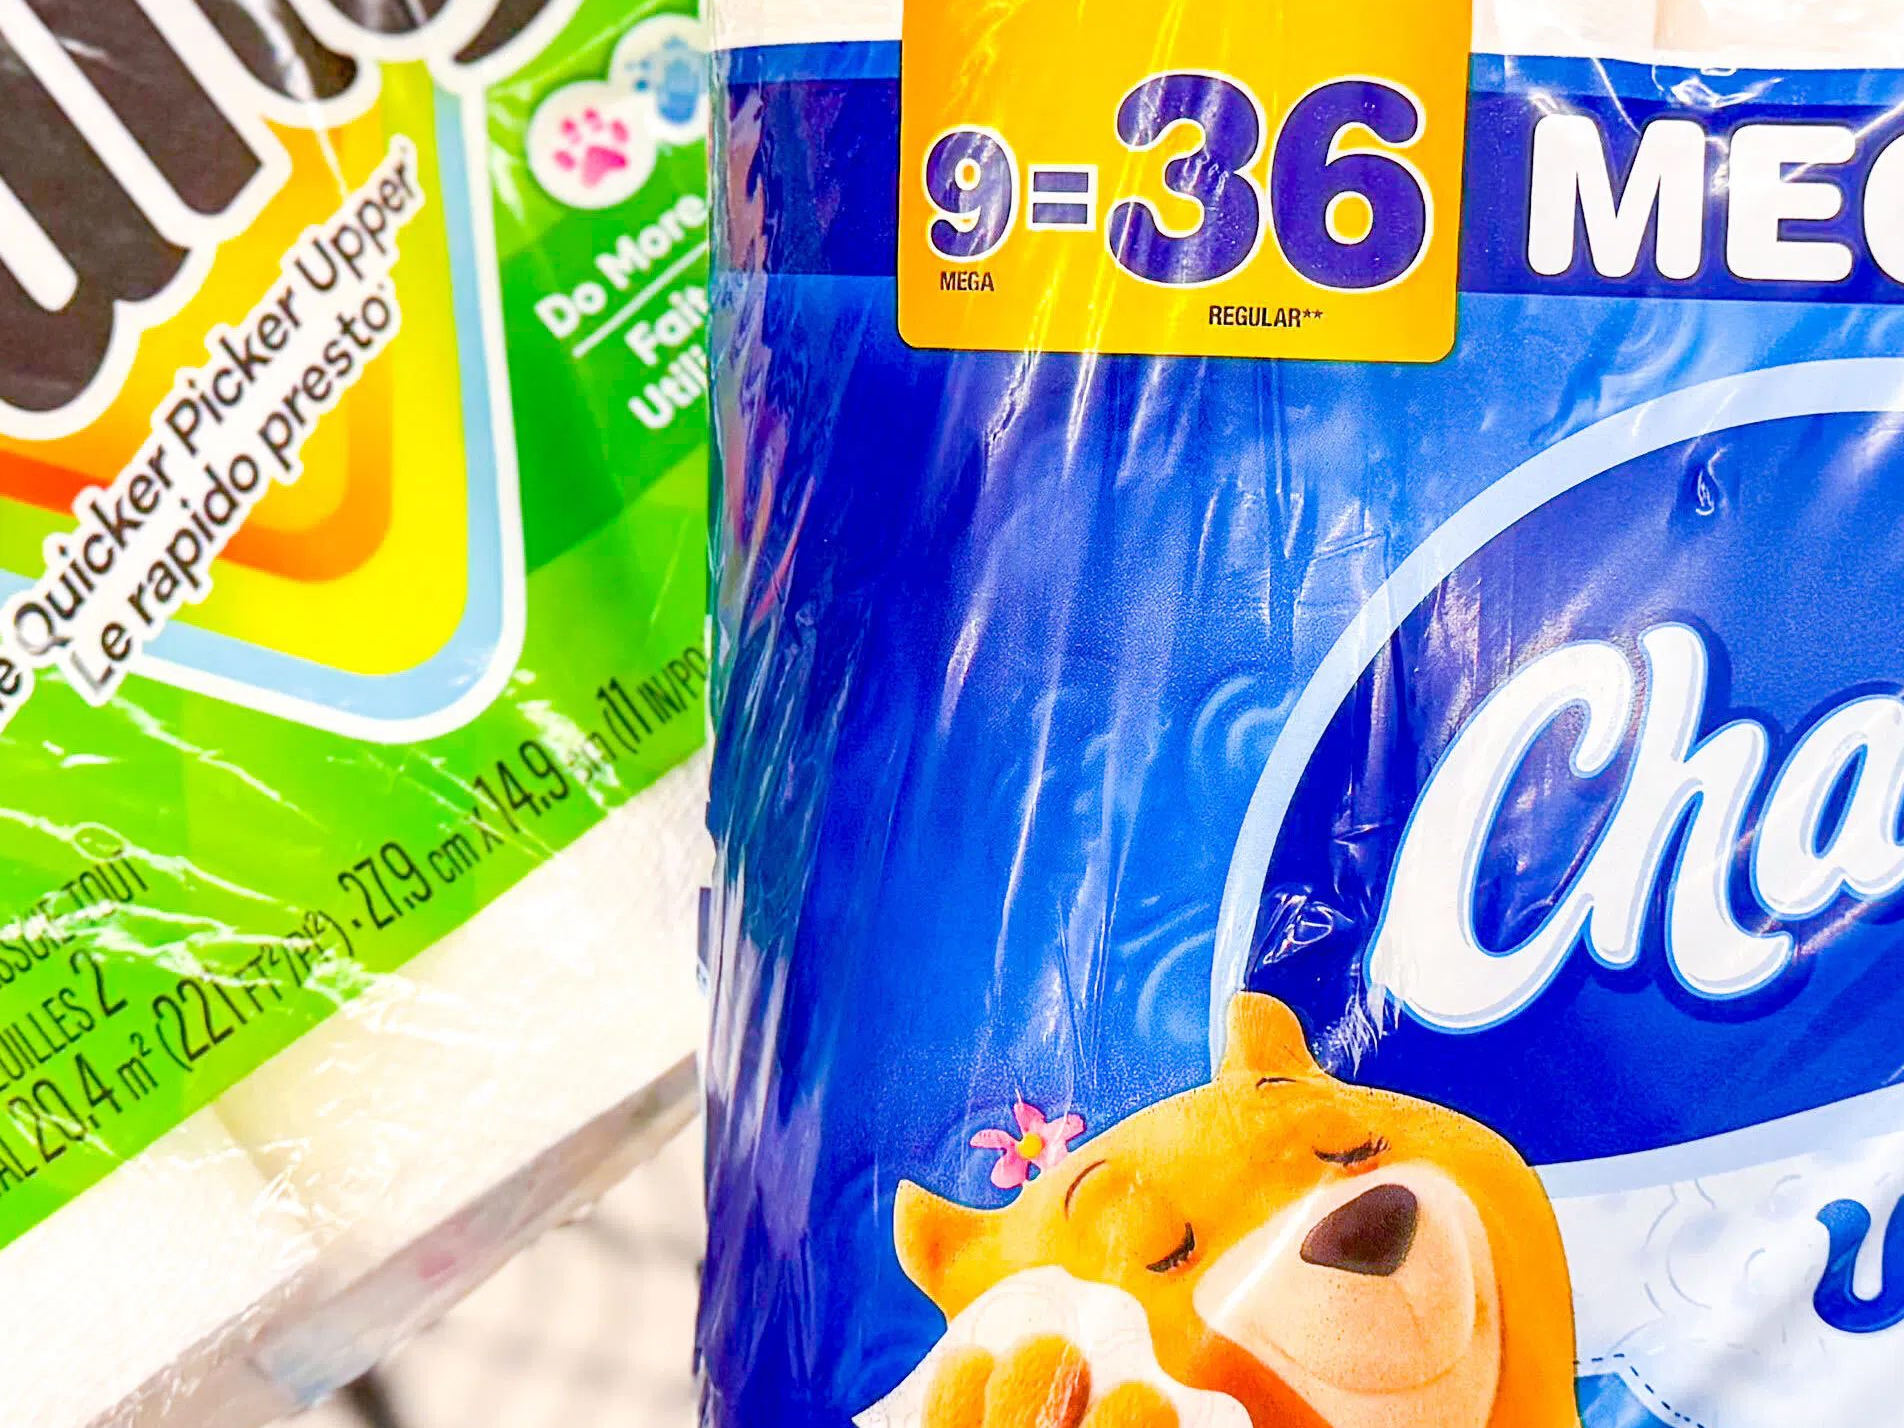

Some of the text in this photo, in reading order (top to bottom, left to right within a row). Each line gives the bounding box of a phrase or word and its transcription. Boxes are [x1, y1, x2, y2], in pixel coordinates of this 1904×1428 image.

[534, 194, 708, 340] Do More
[940, 270, 996, 294] MEGA
[13, 443, 178, 654] Quicker
[165, 290, 303, 457] Picker
[293, 156, 413, 294] Upper
[70, 291, 393, 690] Le rapido presto
[338, 842, 434, 931] 27,9
[428, 831, 481, 885] cm
[71, 948, 128, 1017] 2
